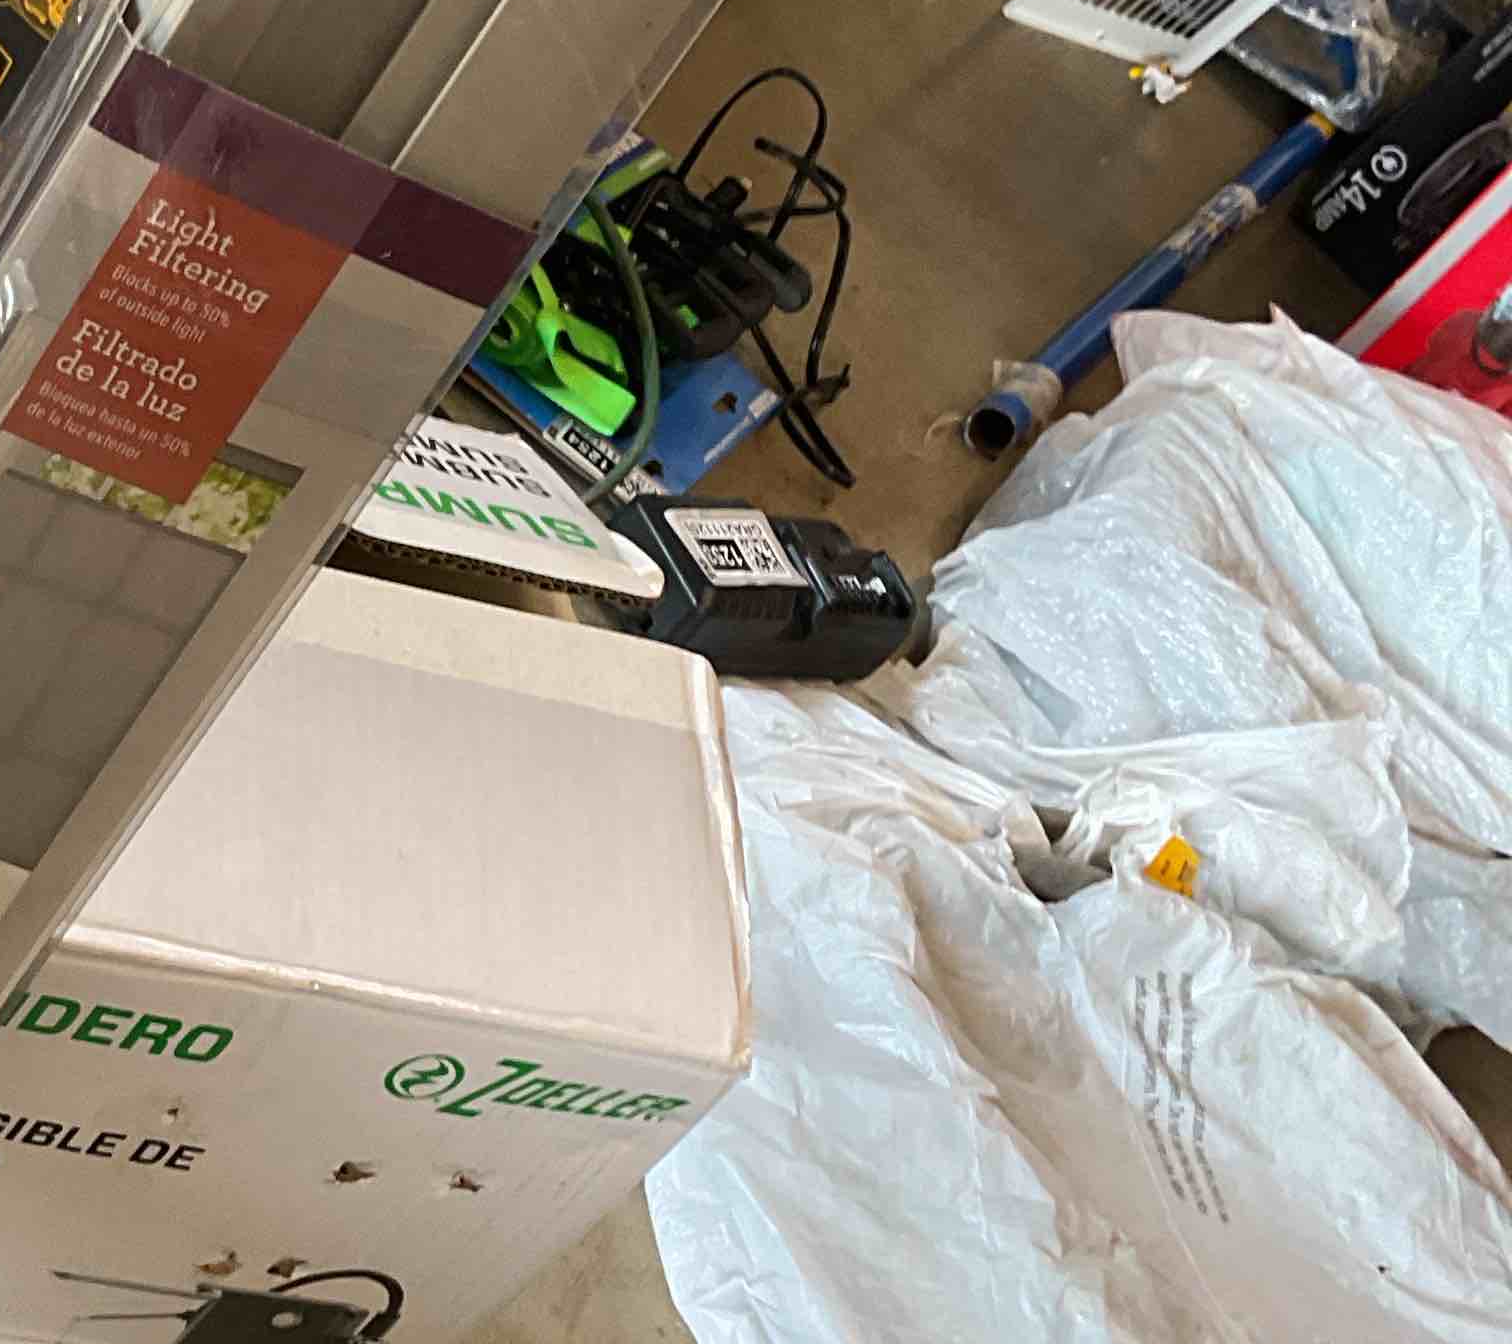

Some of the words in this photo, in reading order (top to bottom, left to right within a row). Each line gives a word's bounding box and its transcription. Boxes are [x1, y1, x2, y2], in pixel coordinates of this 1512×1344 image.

[1350, 169, 1381, 214] 14
[145, 198, 235, 257] Light
[111, 264, 158, 296] Blocks
[160, 286, 180, 308] up
[184, 295, 198, 314] to
[128, 228, 270, 314] Filtering
[99, 287, 115, 301] of
[117, 295, 171, 328] outside
[171, 315, 206, 344] light
[71, 318, 198, 391] Filtrado
[39, 380, 97, 418] Bloquea
[98, 406, 137, 435] hasta
[55, 349, 94, 382] de
[99, 365, 131, 400] la
[136, 380, 187, 422] luz
[26, 402, 46, 420] de
[47, 410, 61, 426] la
[63, 416, 86, 437] luz
[87, 430, 145, 460] exterior
[373, 478, 600, 550] SUMP
[436, 1056, 693, 1119] ZOELLER
[128, 1138, 207, 1173] DE
